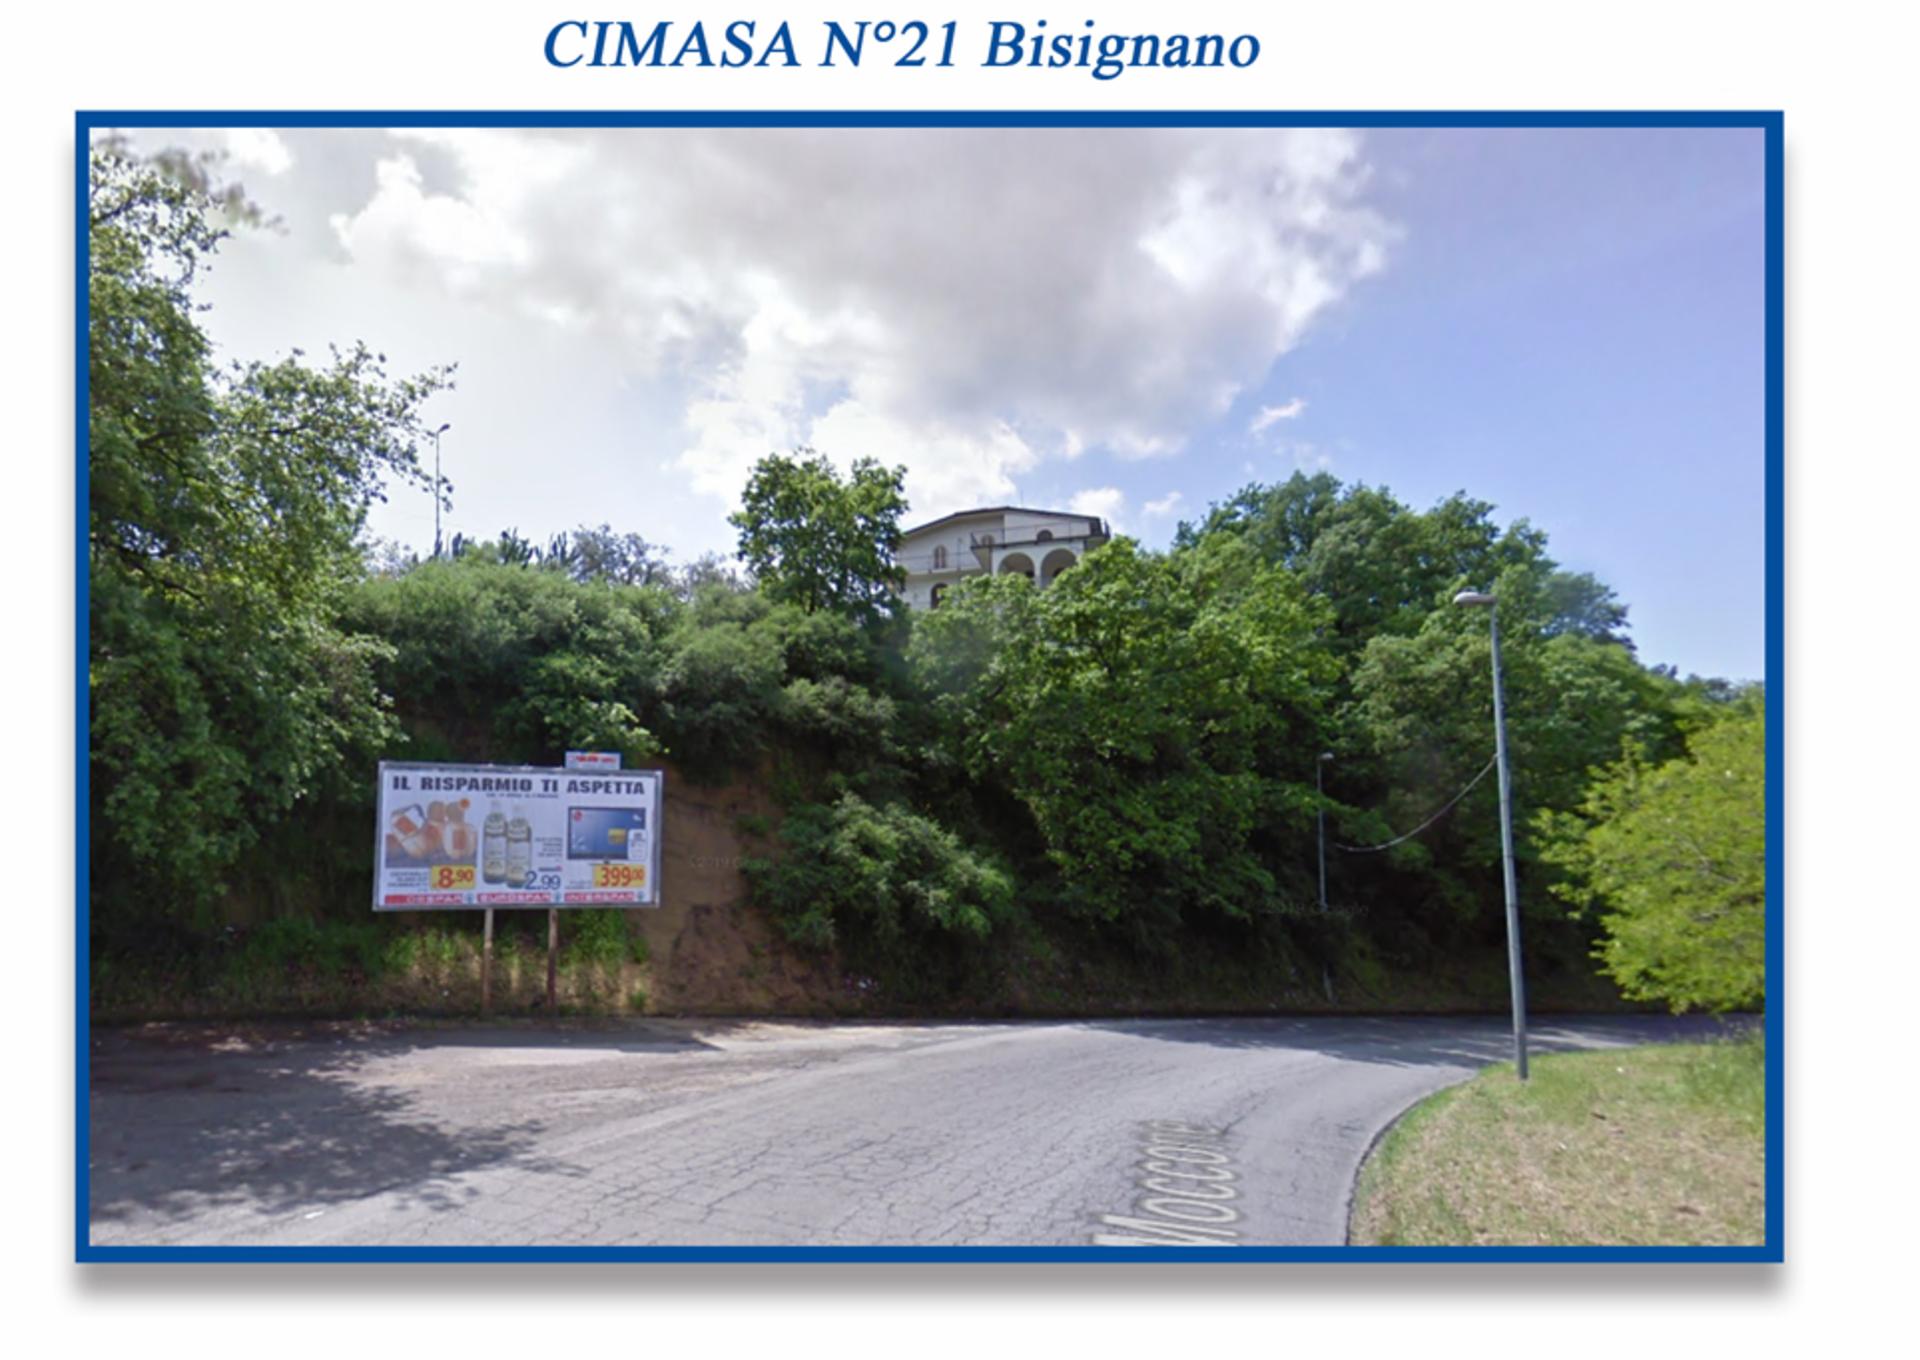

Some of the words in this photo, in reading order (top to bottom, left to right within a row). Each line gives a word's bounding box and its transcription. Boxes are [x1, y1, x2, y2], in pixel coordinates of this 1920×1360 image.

[393, 776, 411, 790] IL
[421, 776, 533, 793] RISPARMIO
[541, 779, 559, 793] TI
[567, 779, 645, 795] ASPETTA
